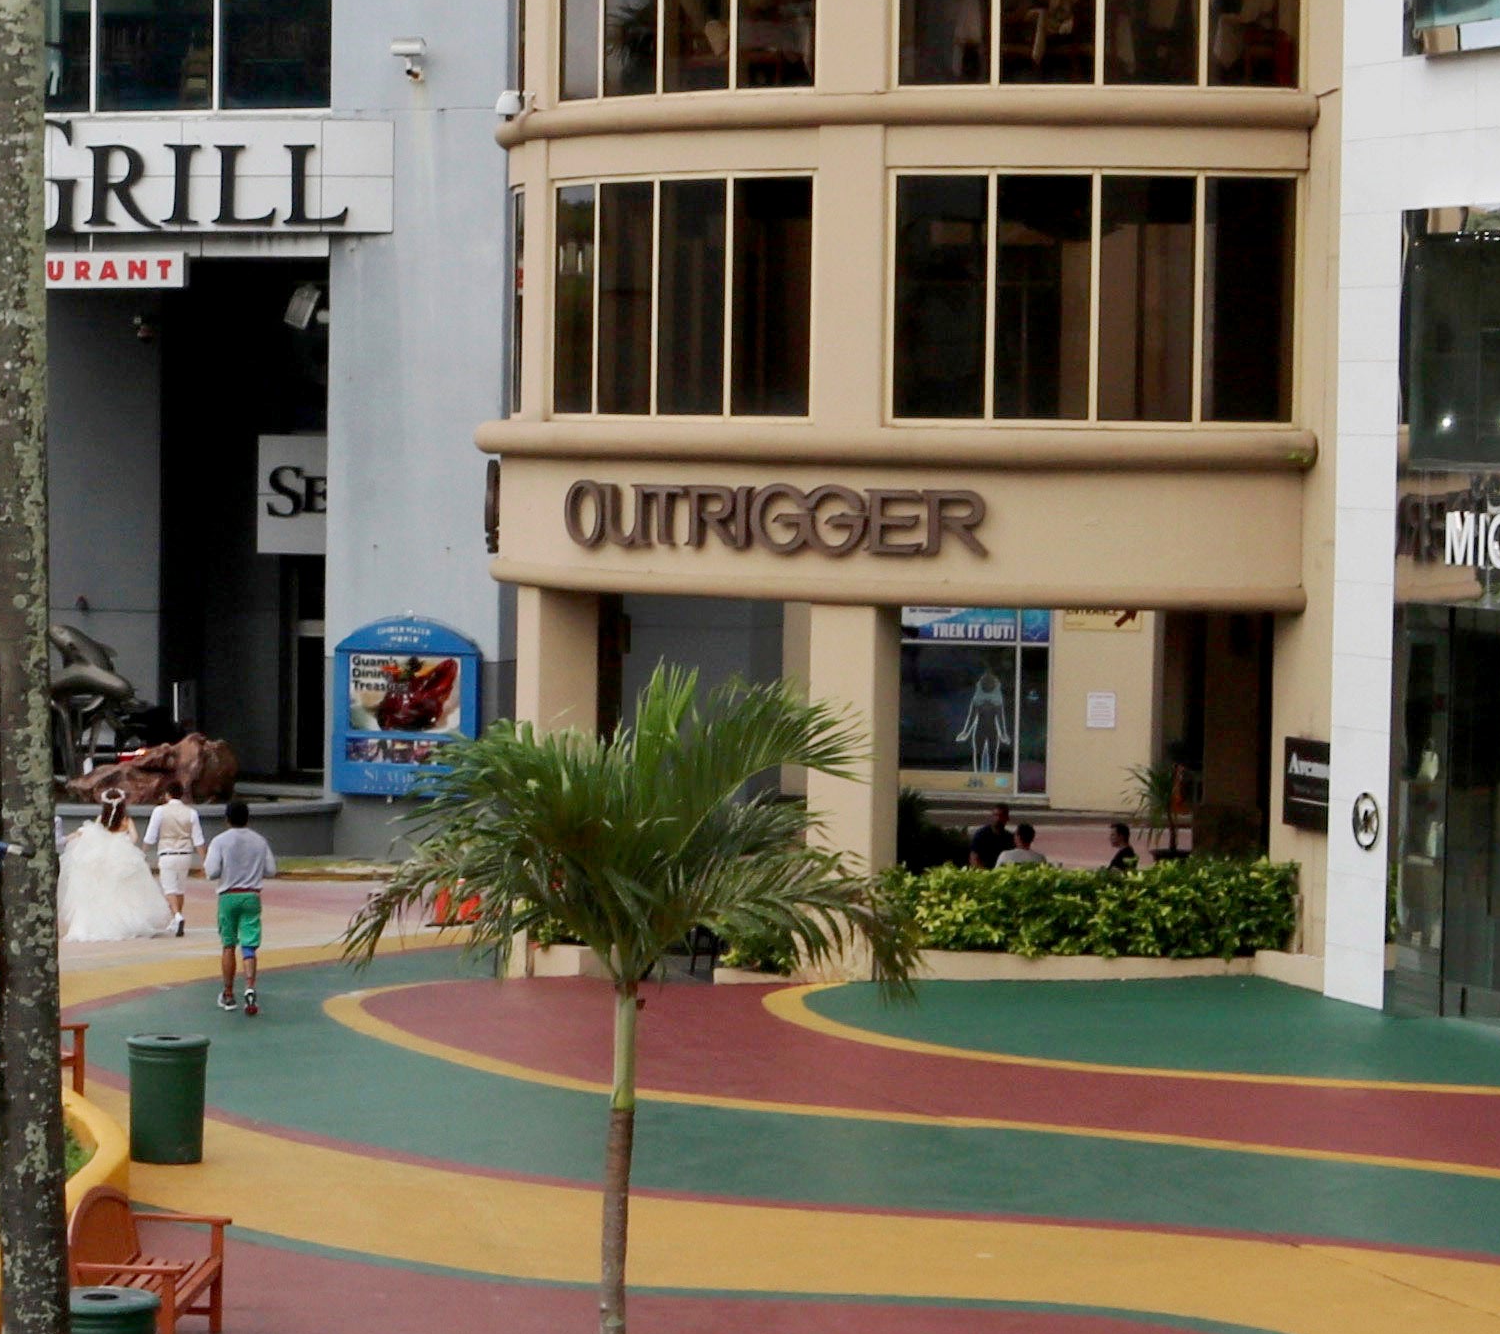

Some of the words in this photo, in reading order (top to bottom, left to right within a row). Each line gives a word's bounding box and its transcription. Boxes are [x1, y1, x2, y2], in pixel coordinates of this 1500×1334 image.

[563, 478, 990, 559] OUTRIGGER
[932, 622, 966, 638] TREK
[967, 623, 981, 639] IT
[985, 624, 1016, 640] OUT!
[352, 654, 398, 667] Guam's
